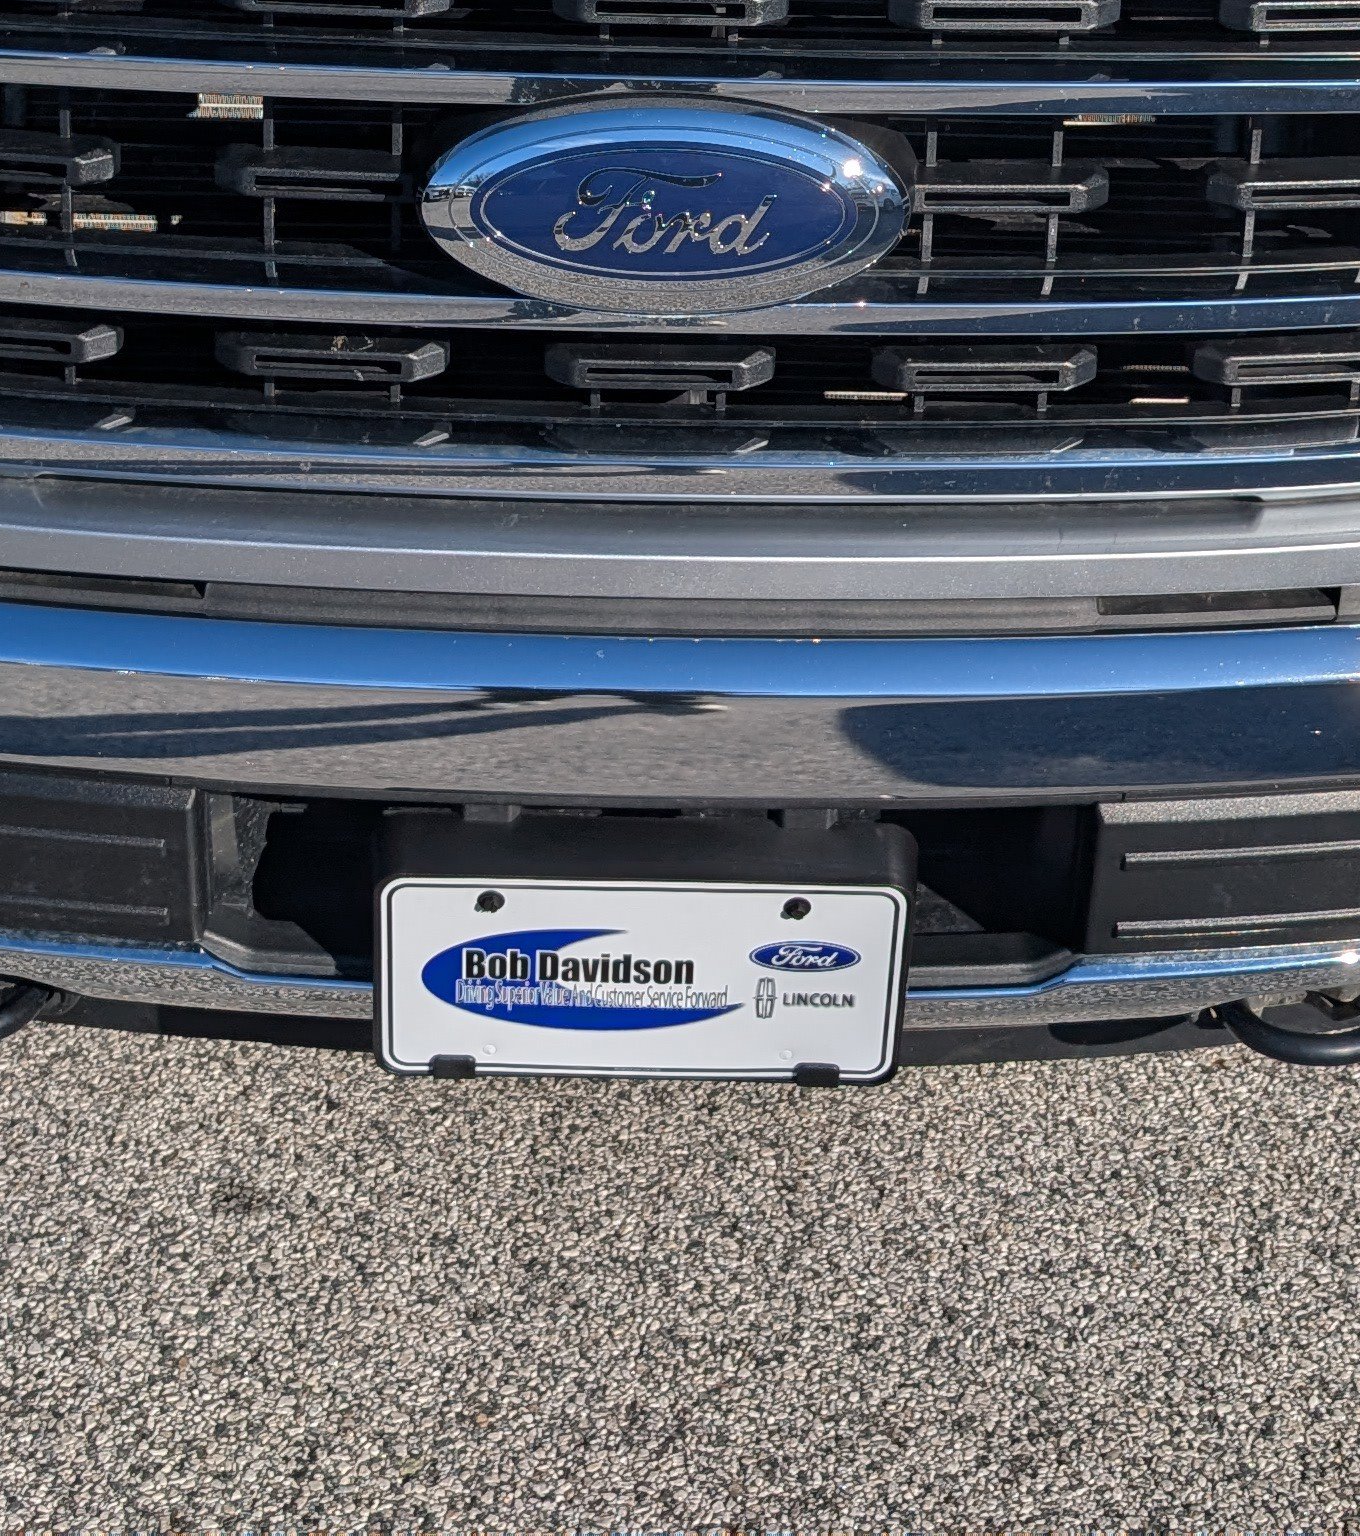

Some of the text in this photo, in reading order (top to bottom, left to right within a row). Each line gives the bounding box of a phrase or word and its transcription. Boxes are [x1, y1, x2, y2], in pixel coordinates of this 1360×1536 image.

[552, 166, 778, 255] Ford
[465, 949, 695, 985] Bob Davidson
[771, 945, 839, 967] Ford
[455, 978, 729, 1011] Driving Superior Value And Customer Service Forward
[782, 992, 855, 1007] LINCOLN
